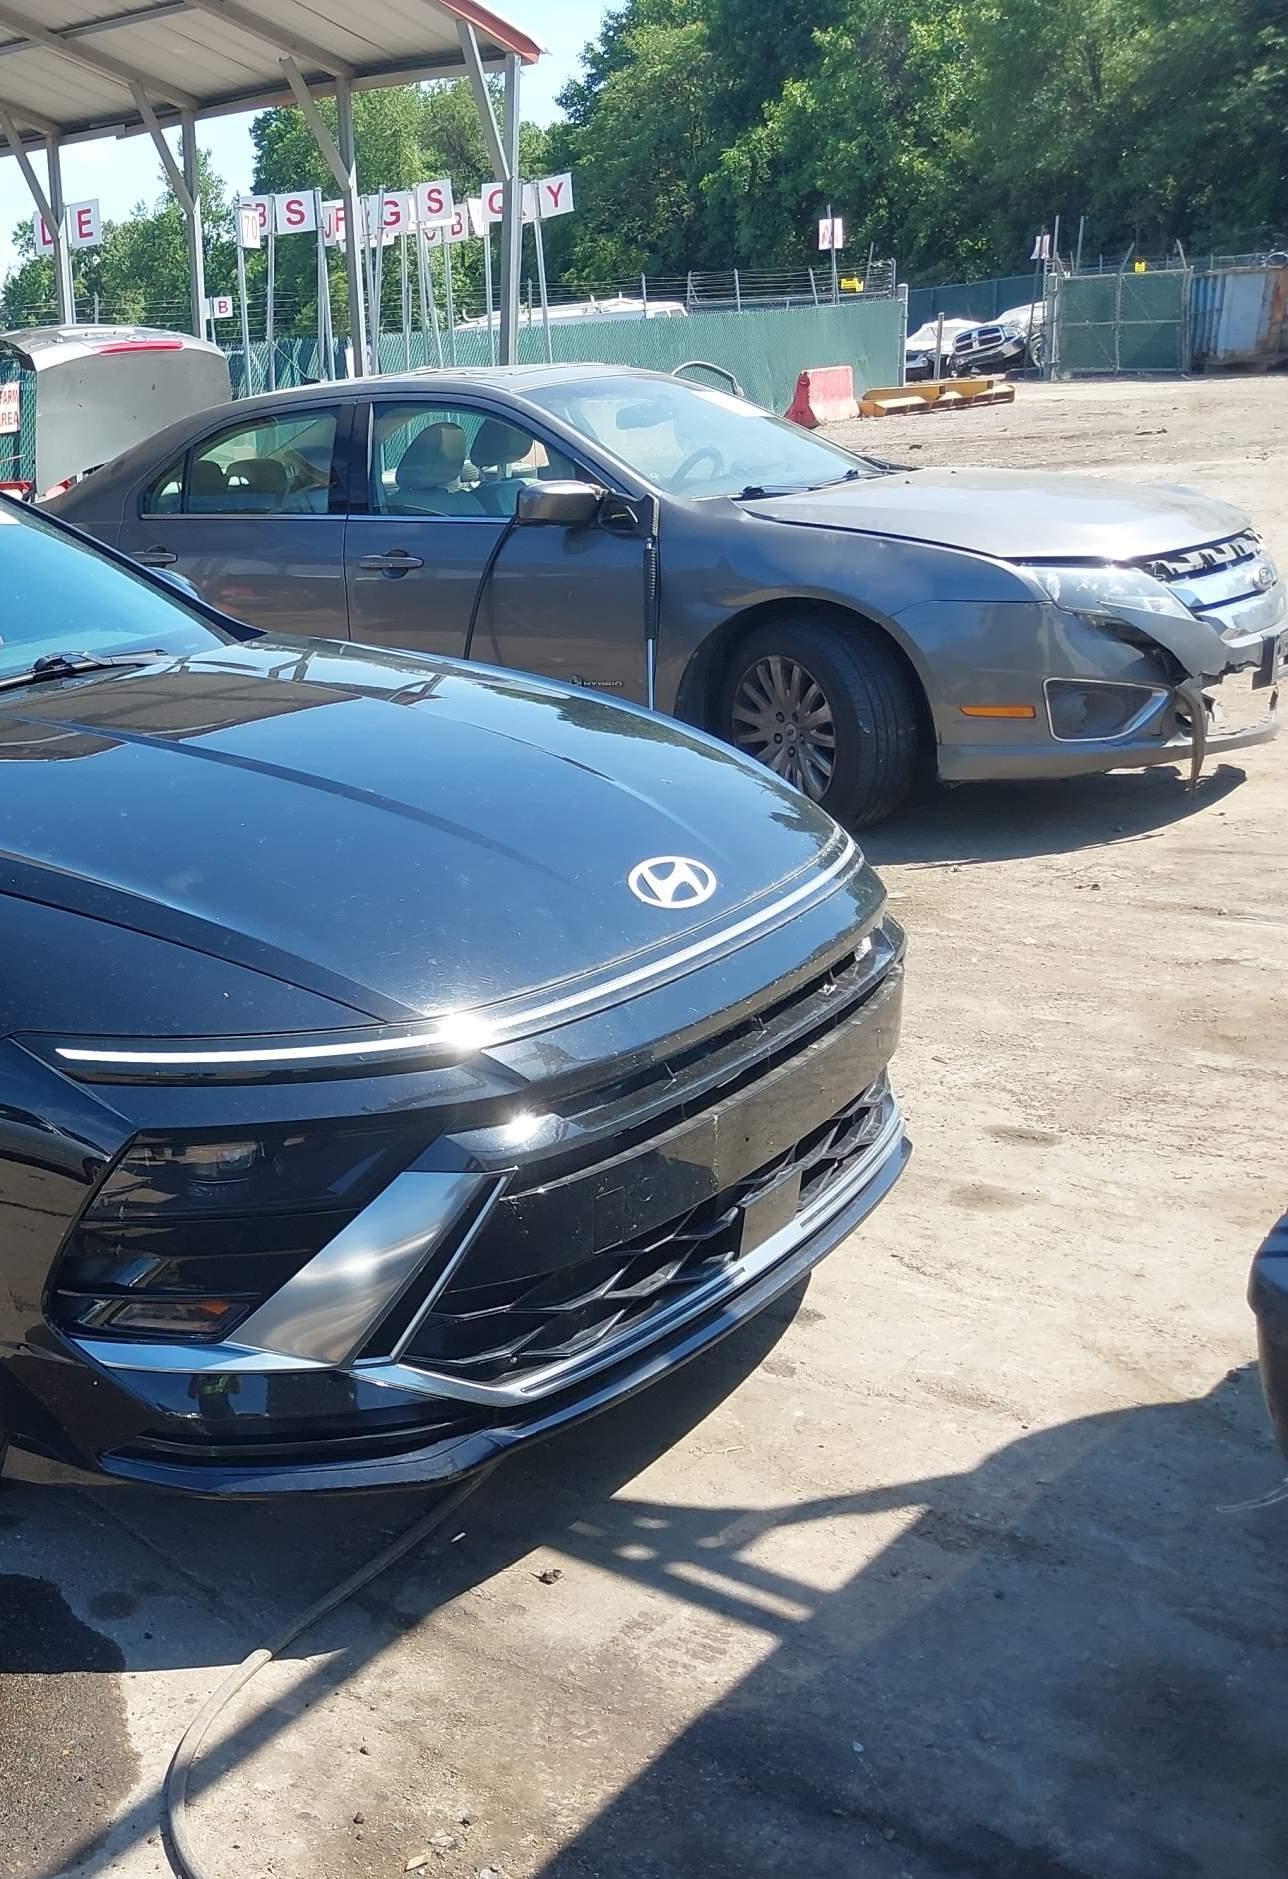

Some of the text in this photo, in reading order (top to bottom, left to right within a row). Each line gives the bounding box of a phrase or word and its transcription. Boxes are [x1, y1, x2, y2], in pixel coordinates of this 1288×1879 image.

[427, 188, 444, 214] S
[546, 182, 564, 208] Y
[77, 208, 94, 239] E
[286, 199, 305, 225] S
[383, 200, 401, 227] G
[218, 300, 228, 313] B
